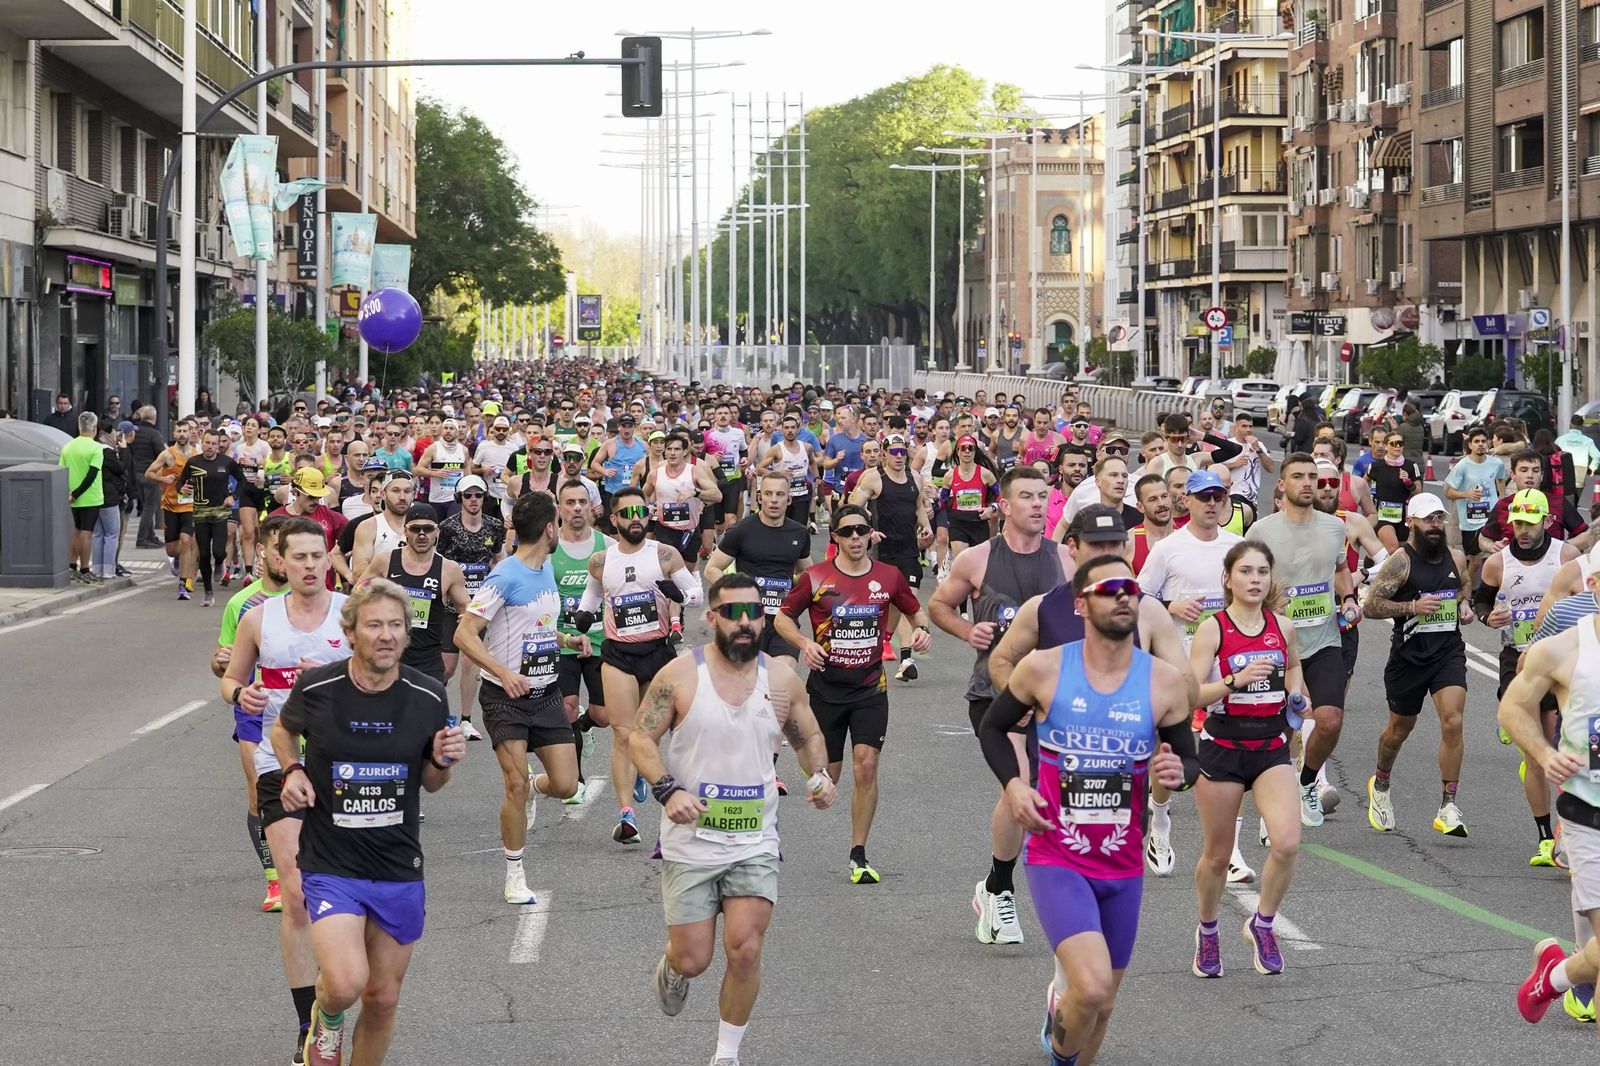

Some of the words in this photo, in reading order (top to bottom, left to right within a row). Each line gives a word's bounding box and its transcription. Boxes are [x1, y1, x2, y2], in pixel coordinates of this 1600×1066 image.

[303, 192, 314, 262] ENTOFT
[1318, 317, 1343, 325] TINTE
[1300, 585, 1325, 594] ZURICH
[625, 593, 650, 603] ZURICH
[868, 592, 890, 600] AAMA
[762, 597, 782, 606] DUDU
[1203, 600, 1225, 608] ZURIC
[848, 607, 875, 615] ZURICH
[1292, 605, 1326, 618] ARTHUR
[625, 614, 648, 626] ISMA
[1424, 611, 1455, 624] CARLOS
[538, 643, 558, 651] ZURICH
[831, 647, 872, 657] CRIANÇAS
[829, 655, 871, 665] ESPECIAIS
[528, 662, 555, 675] MANUÉ
[1247, 679, 1271, 692] INES
[1108, 710, 1141, 722] apyou
[1066, 724, 1087, 733] CLUB
[1087, 726, 1134, 738] DEPORTIVO
[1049, 729, 1149, 755] CREDUS
[358, 767, 400, 777] ZURICH
[1083, 779, 1107, 789] 3707
[359, 786, 382, 796] 4133
[723, 788, 758, 798] ZURICH
[343, 797, 397, 813] CARLOS
[1068, 792, 1122, 808] LUENGO
[723, 806, 743, 815] 1623
[703, 816, 758, 830] ALBERTO
